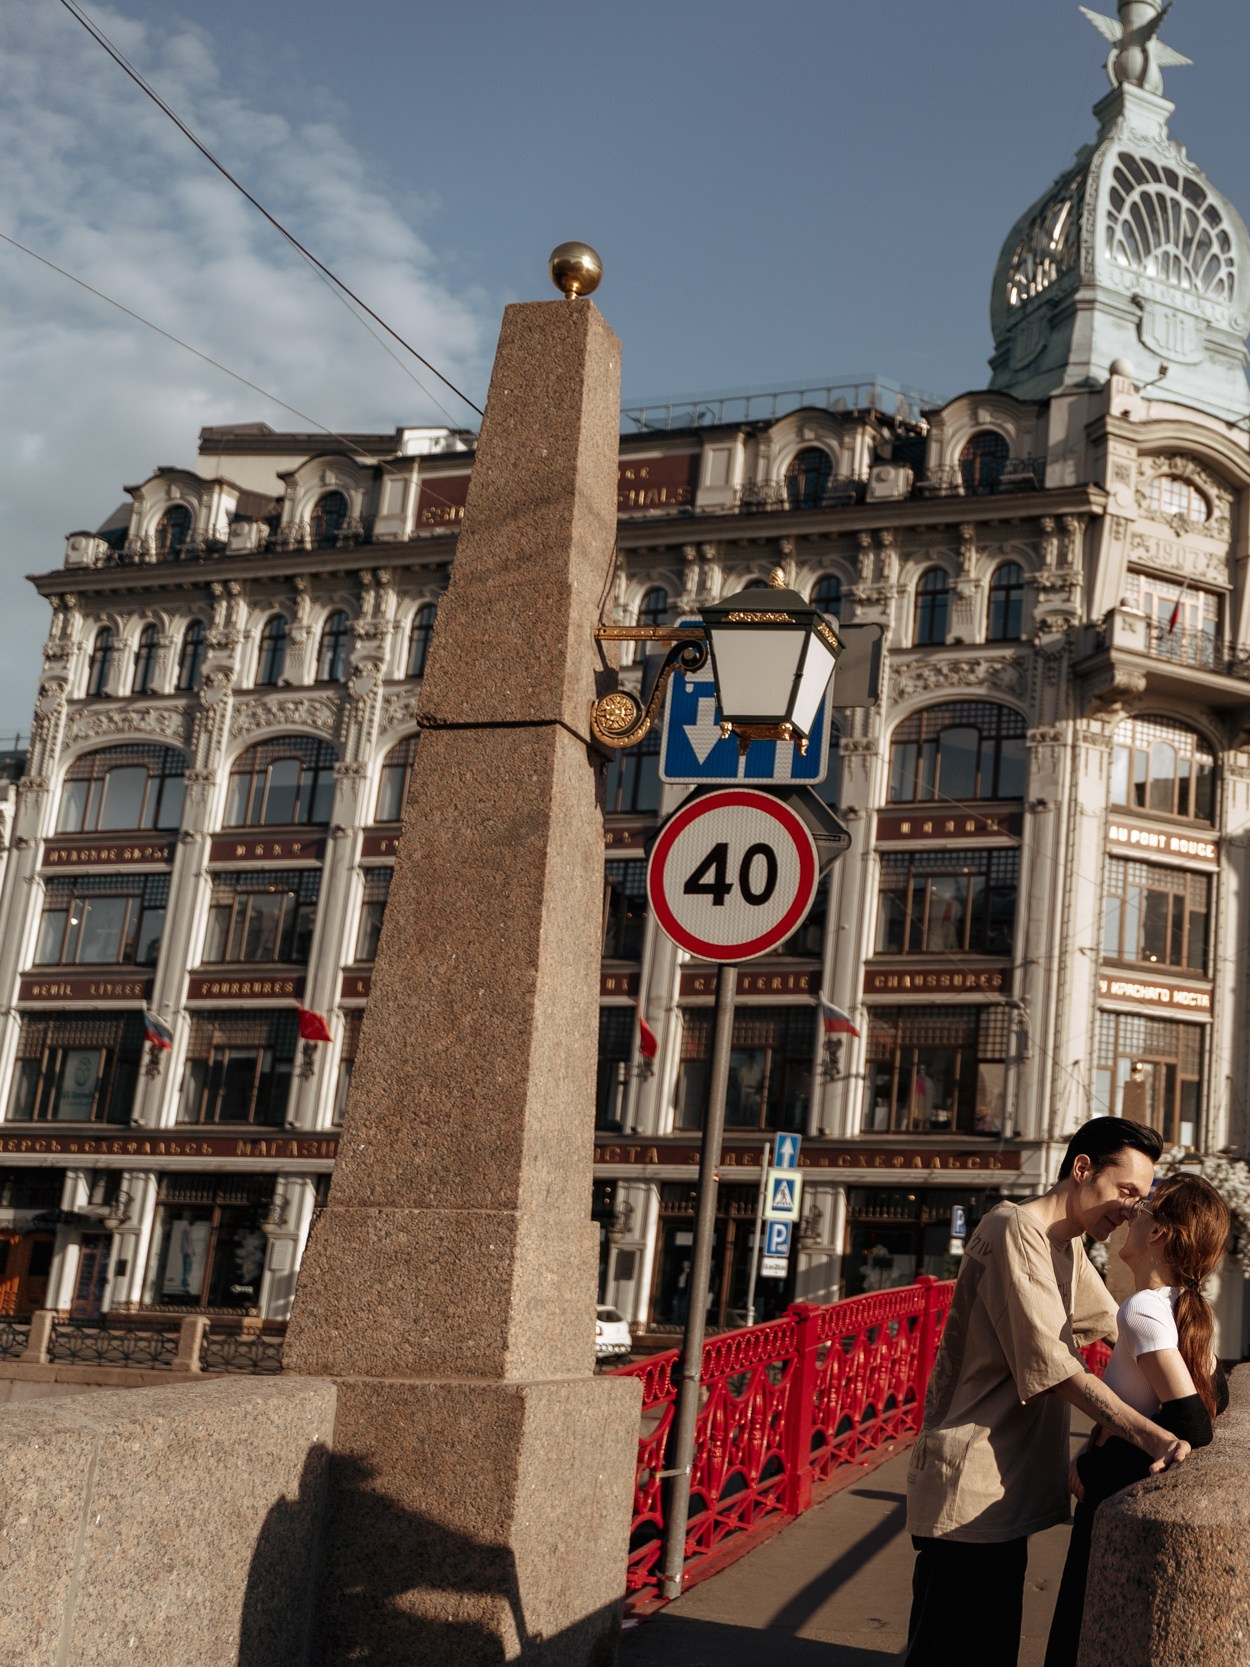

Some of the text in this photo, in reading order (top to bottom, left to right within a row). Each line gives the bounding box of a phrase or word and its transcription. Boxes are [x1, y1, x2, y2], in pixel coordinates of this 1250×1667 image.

[1152, 540, 1199, 569] 1907
[1108, 825, 1214, 858] AU PONT ROUGE
[683, 842, 778, 906] 40
[201, 981, 293, 996] FOURRURES
[874, 974, 1002, 989] CHAUSSURES
[0, 1139, 61, 1153] ЕРСЪ
[235, 1139, 335, 1157] МАГАЗИ
